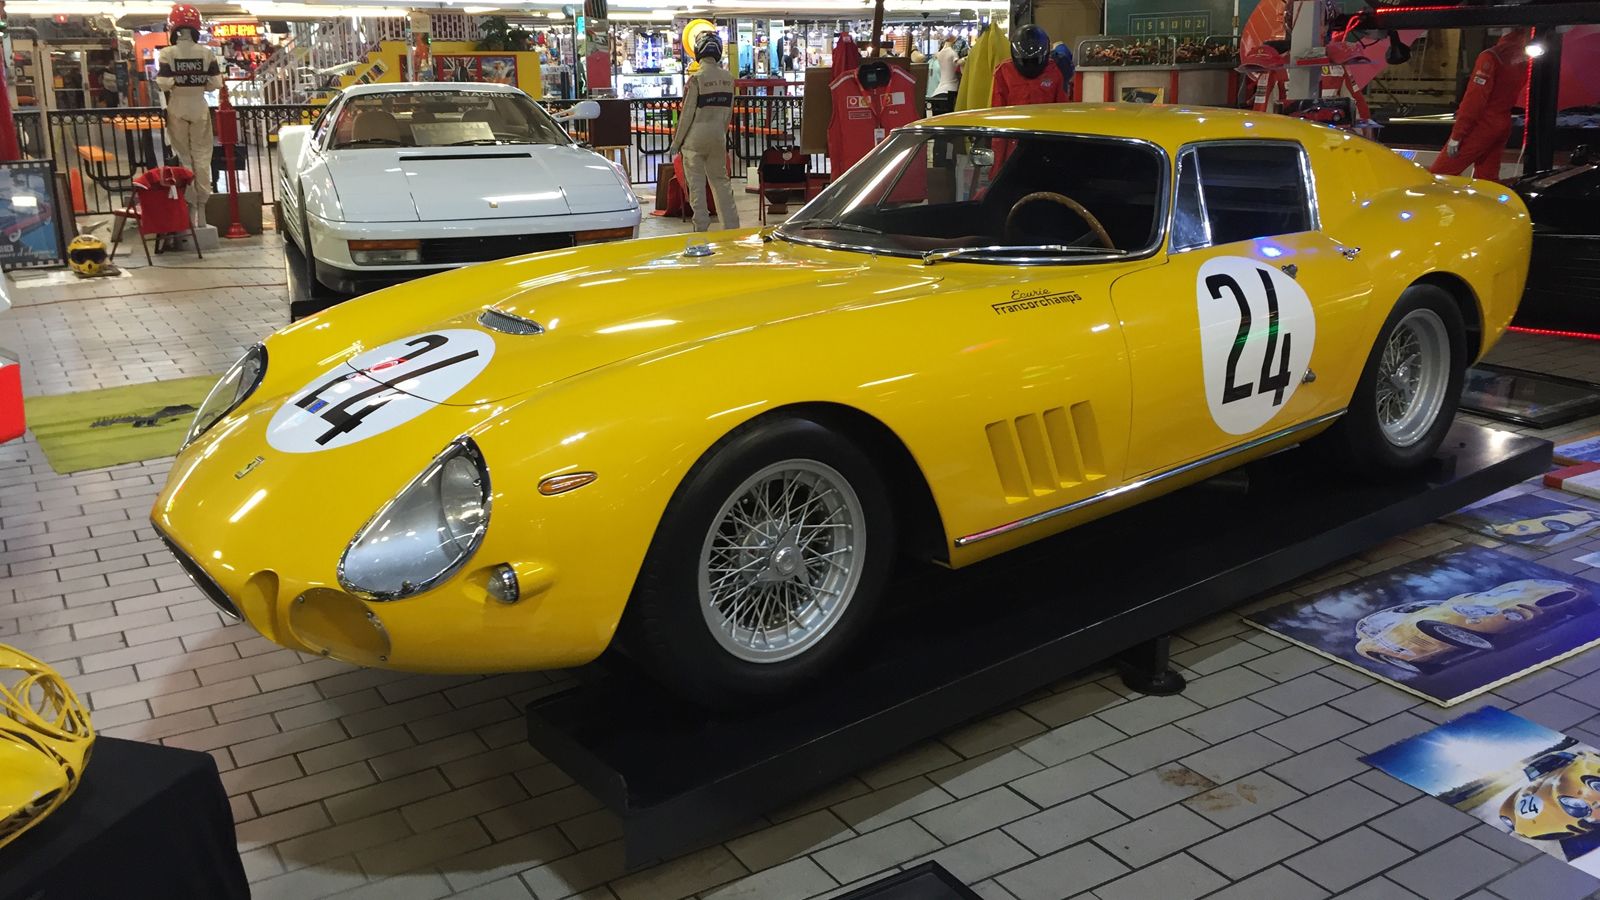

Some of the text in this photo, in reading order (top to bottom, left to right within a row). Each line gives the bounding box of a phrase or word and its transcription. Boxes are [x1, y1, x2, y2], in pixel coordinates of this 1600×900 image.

[363, 92, 406, 100] SWAP
[459, 91, 516, 99] RACING
[992, 293, 1082, 315] Francorchamps
[1011, 288, 1051, 300] Ecurie
[1205, 268, 1291, 407] 24
[294, 334, 479, 446] 24
[1520, 796, 1538, 814] 24
